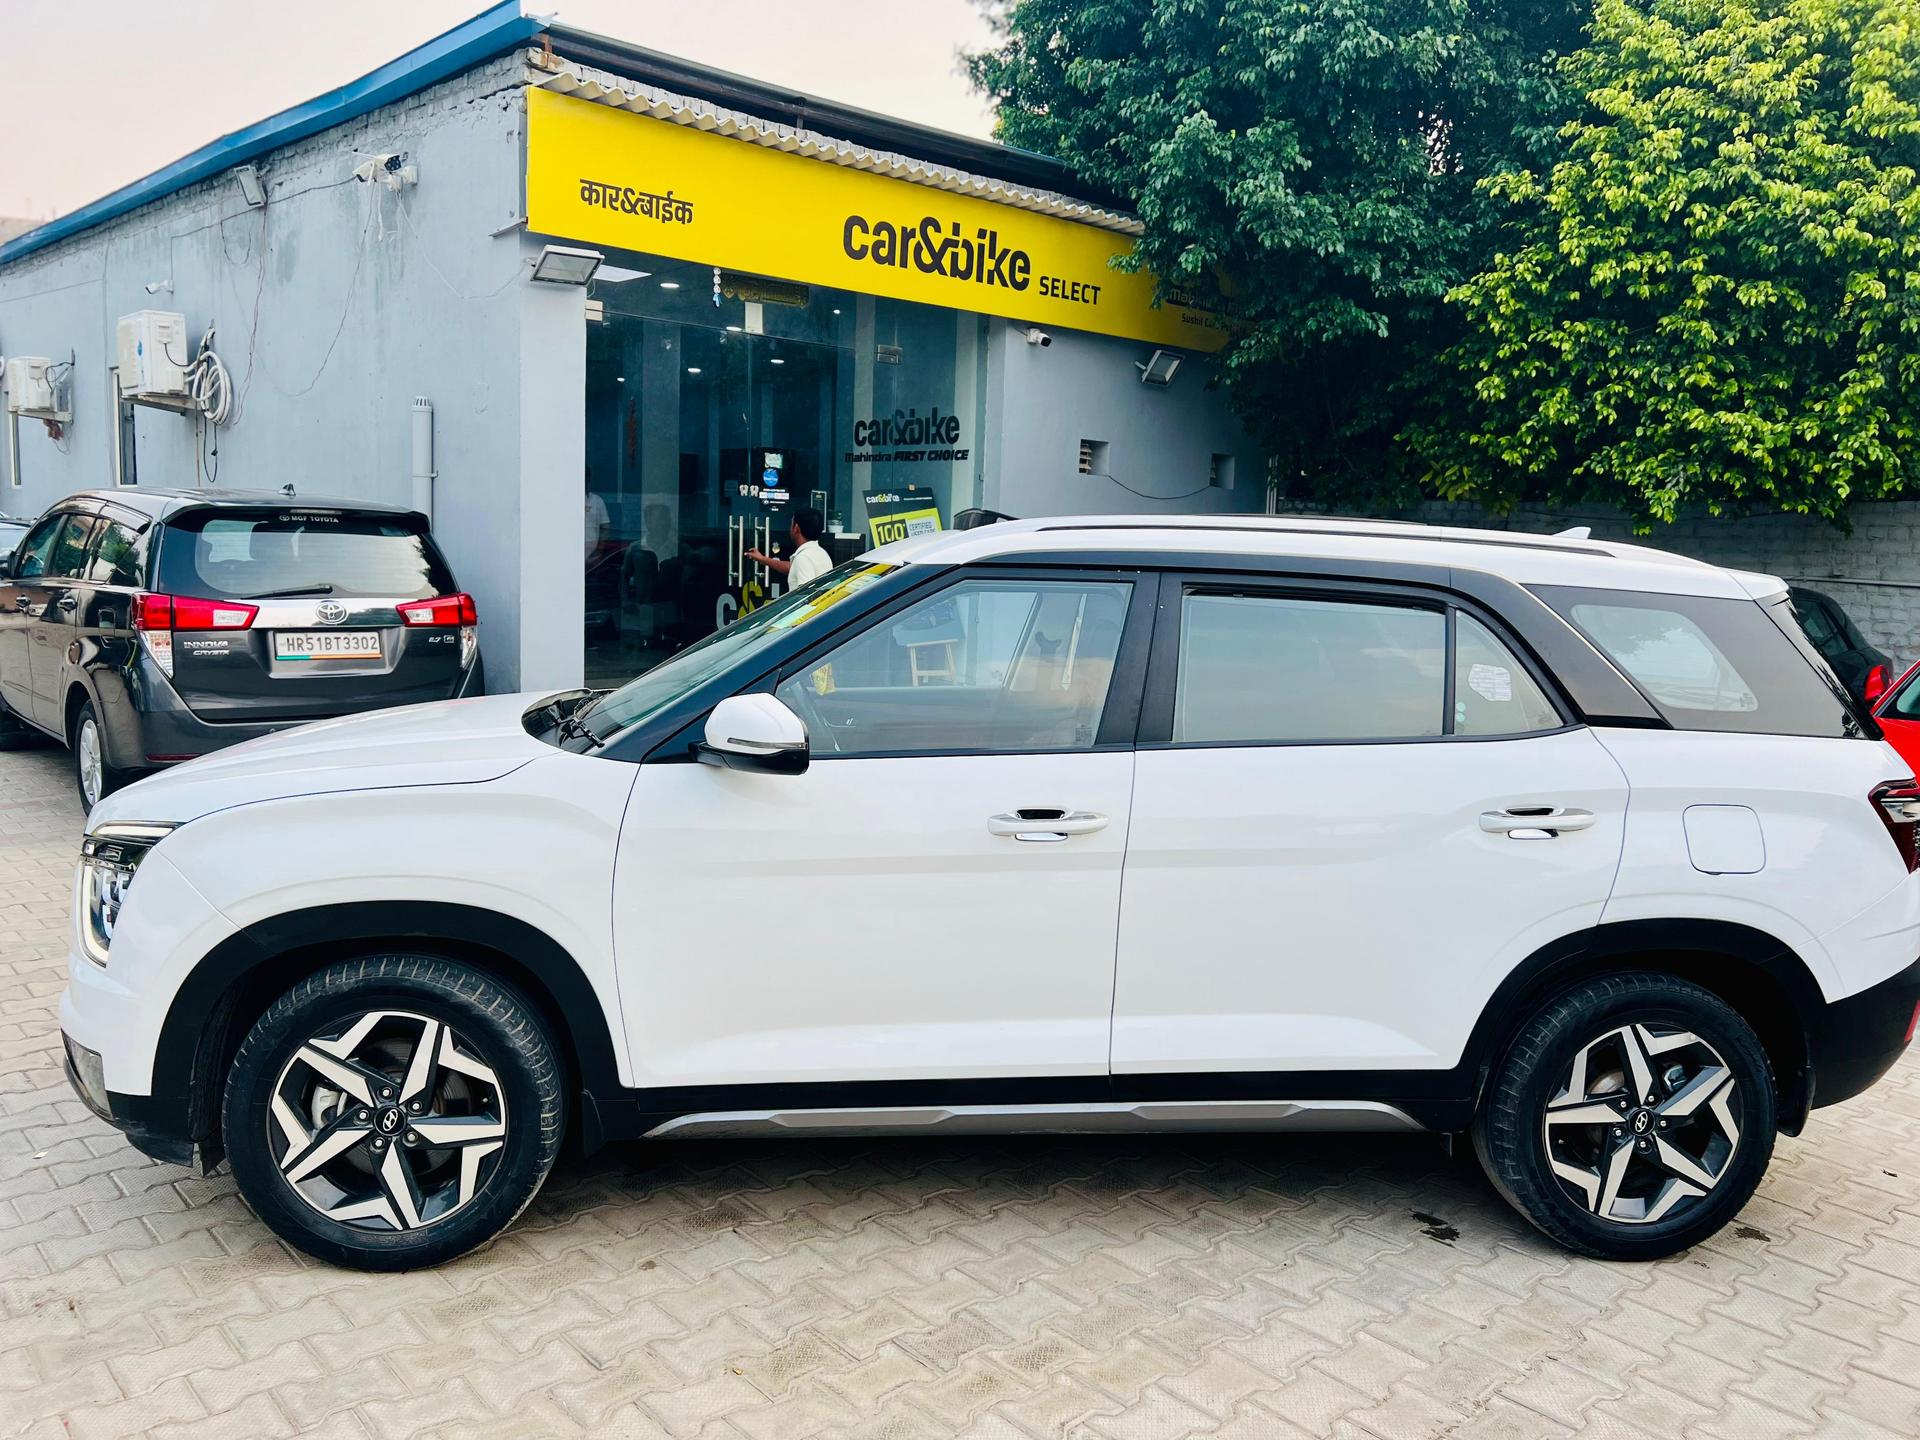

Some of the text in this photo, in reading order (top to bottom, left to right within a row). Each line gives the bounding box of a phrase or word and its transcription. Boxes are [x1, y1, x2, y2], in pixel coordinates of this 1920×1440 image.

[842, 214, 1101, 305] car&bike SELECT
[854, 406, 960, 447] car&bike
[893, 450, 928, 462] FIRST
[927, 449, 970, 460] CHOICE
[183, 640, 229, 649] INNOVA
[286, 636, 378, 652] HR51BT3302
